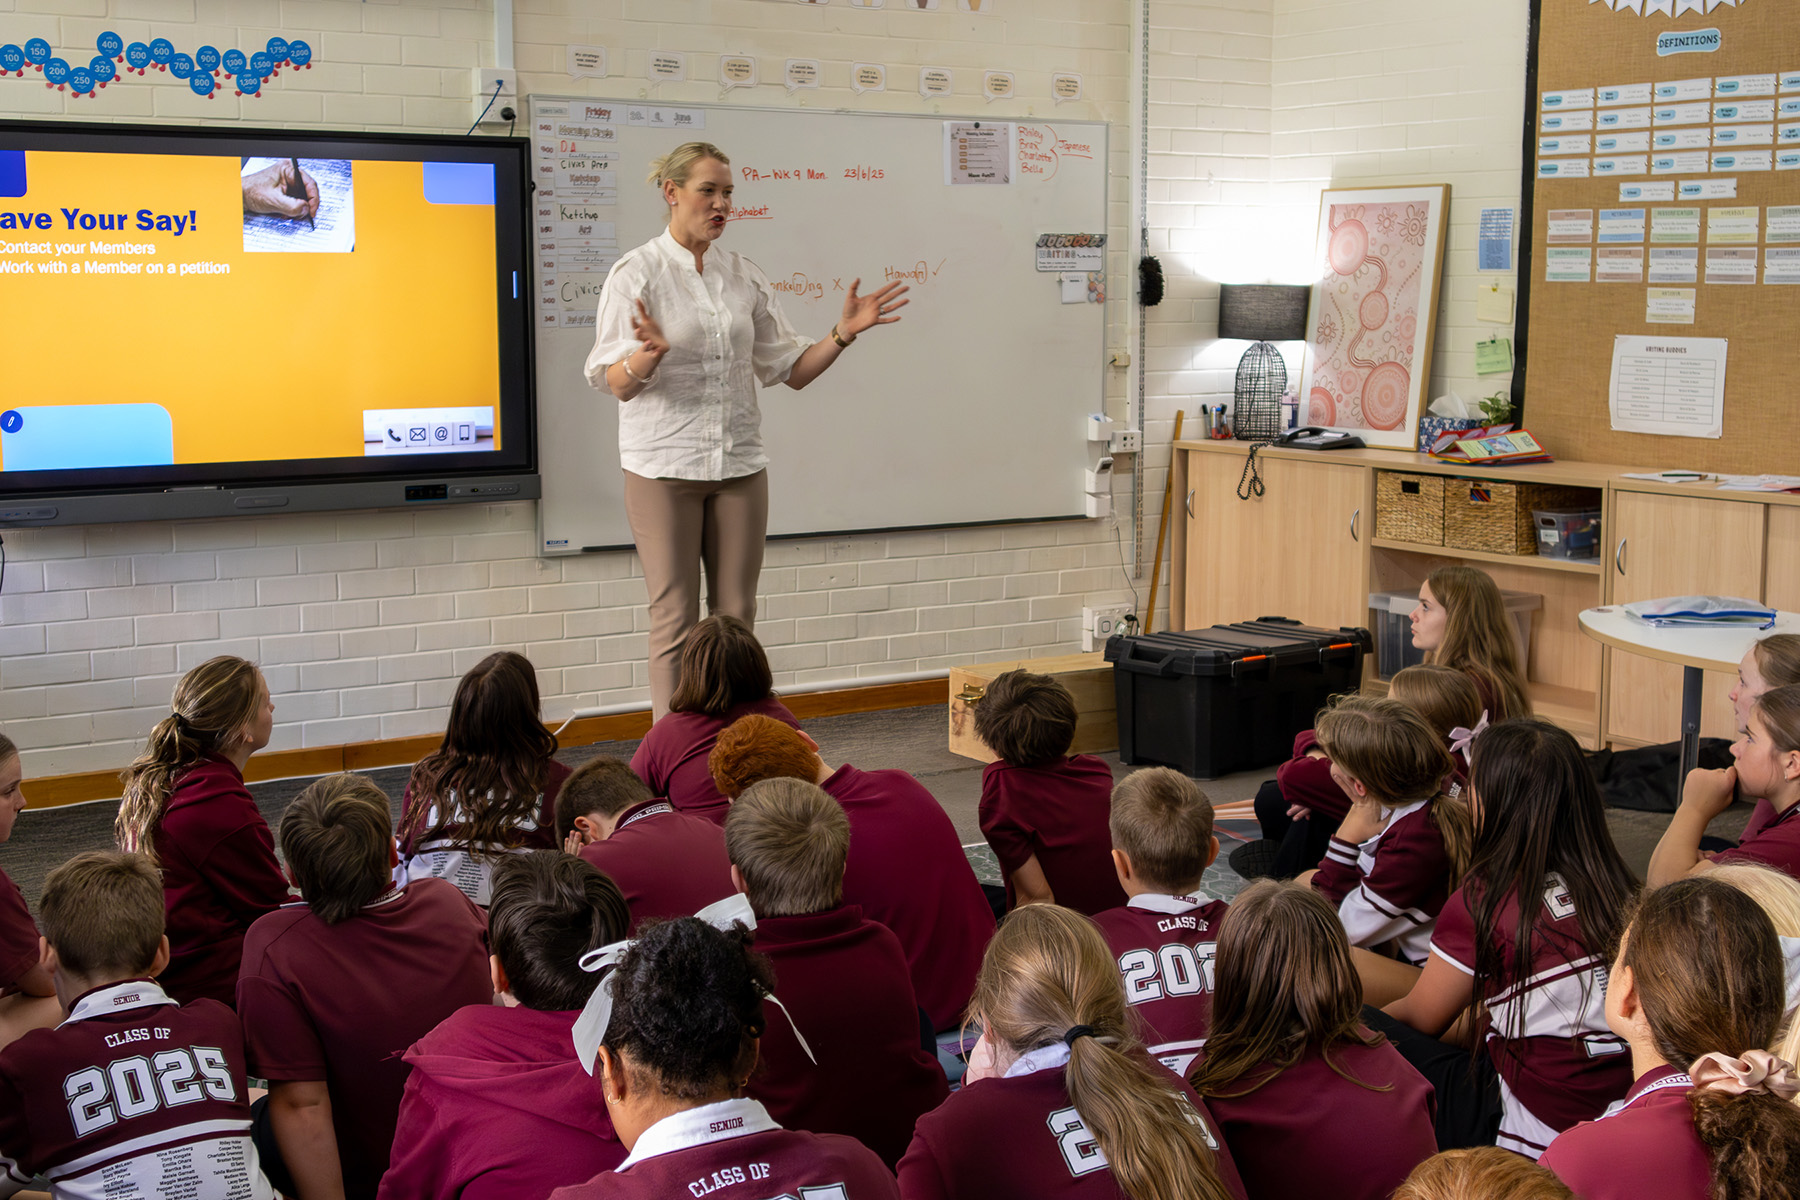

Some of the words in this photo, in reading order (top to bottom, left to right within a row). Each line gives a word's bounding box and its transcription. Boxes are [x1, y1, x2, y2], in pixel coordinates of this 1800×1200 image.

[102, 40, 118, 49] 400
[1659, 34, 1719, 48] DEFINITIONS
[30, 48, 46, 56] 150
[94, 65, 111, 73] 325
[74, 76, 90, 85] 250
[1019, 138, 1039, 150] Brax
[1058, 140, 1091, 152] Japanese
[1018, 151, 1053, 162] Charlotte
[844, 165, 885, 181] 23/6/25
[560, 204, 598, 221] Ketchup
[729, 205, 769, 219] Alphabet
[0, 212, 52, 230] ave
[60, 208, 128, 230] Your
[136, 209, 197, 236] Say!
[0, 240, 51, 255] Contact
[55, 242, 86, 256] your
[90, 241, 156, 255] Members
[0, 261, 34, 274] Work
[38, 261, 68, 274] with
[71, 264, 80, 274] a
[84, 261, 142, 274] Member
[146, 264, 164, 274] on
[166, 264, 176, 274] a
[180, 261, 230, 276] petition
[1157, 916, 1196, 933] CLASS
[113, 994, 141, 1006] SENIOR
[104, 1028, 150, 1048] CLASS
[154, 1027, 171, 1039] OF
[64, 1045, 237, 1139] 2025
[710, 1117, 744, 1133] SENIOR
[168, 1146, 193, 1155] Rosenberg
[115, 1161, 133, 1169] McLean
[688, 1166, 746, 1198] CLASS
[749, 1162, 770, 1180] OF
